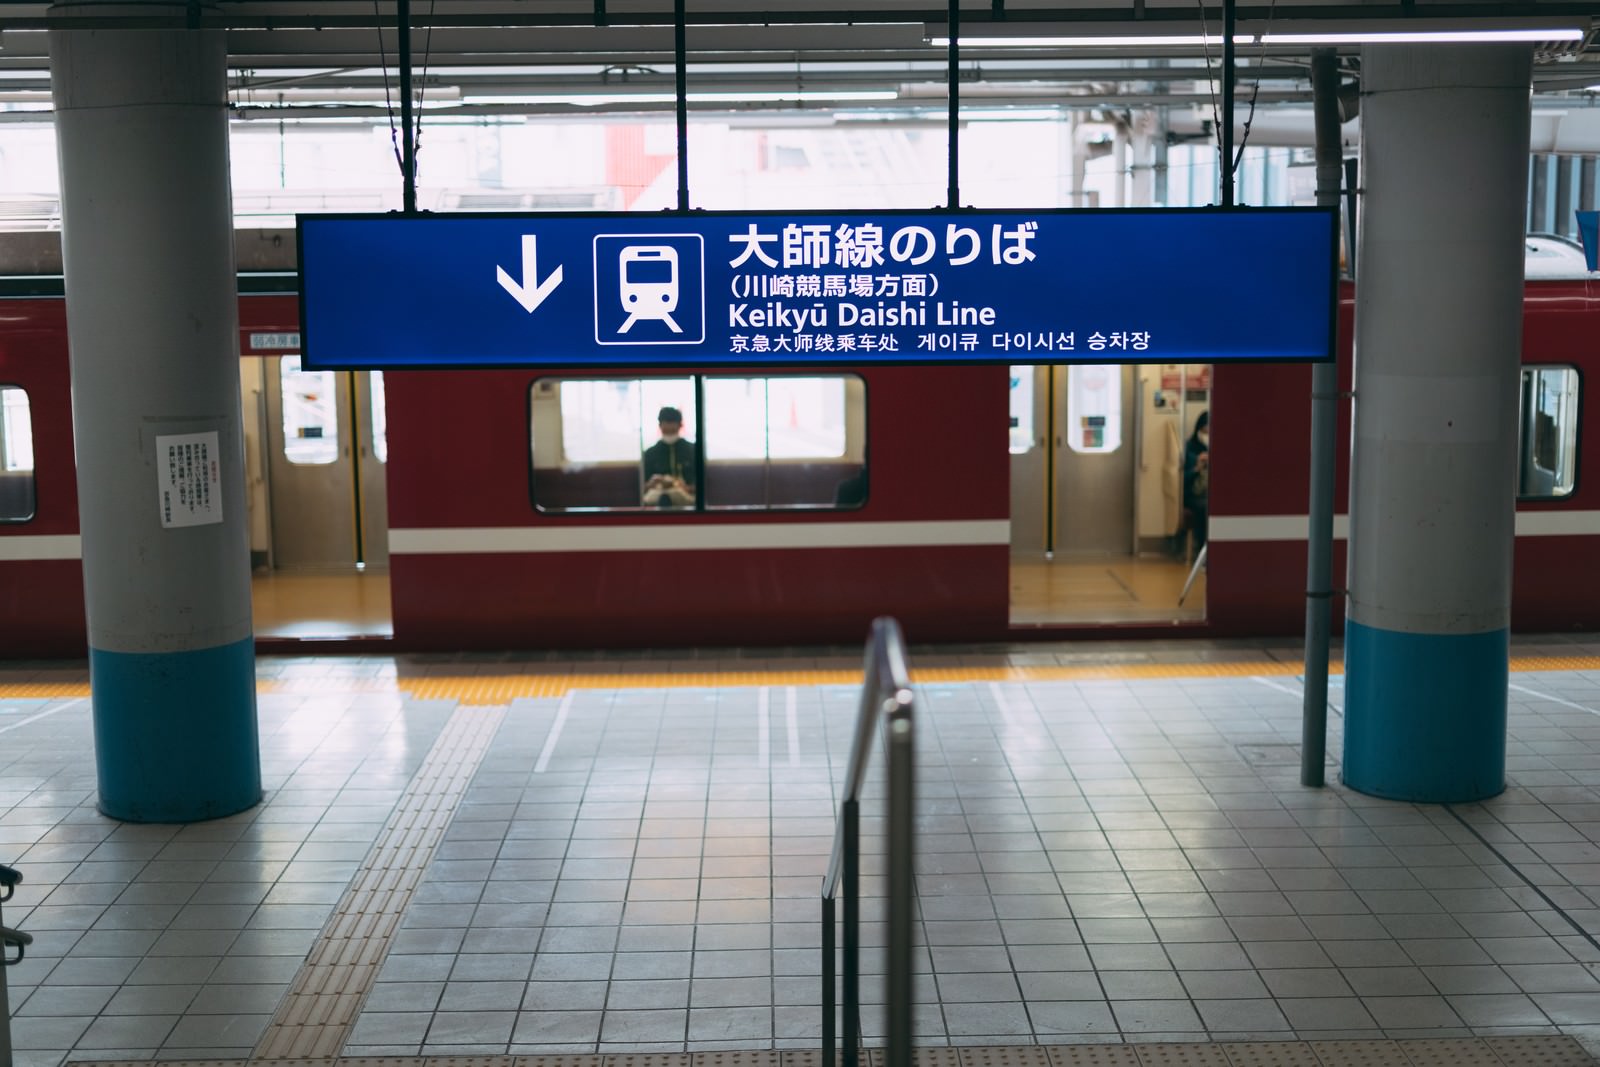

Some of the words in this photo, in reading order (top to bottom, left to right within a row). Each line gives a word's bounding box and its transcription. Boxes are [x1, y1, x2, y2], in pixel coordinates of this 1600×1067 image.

[729, 221, 1038, 268] 大師線のりば
[732, 274, 938, 299] （川崎競馬場方面）
[730, 302, 827, 331] Keikyū
[838, 301, 926, 326] Daishi
[938, 301, 996, 325] Line
[918, 333, 980, 352] 게이큐
[993, 332, 1075, 351] 다이시선
[1088, 332, 1151, 351] 승차장
